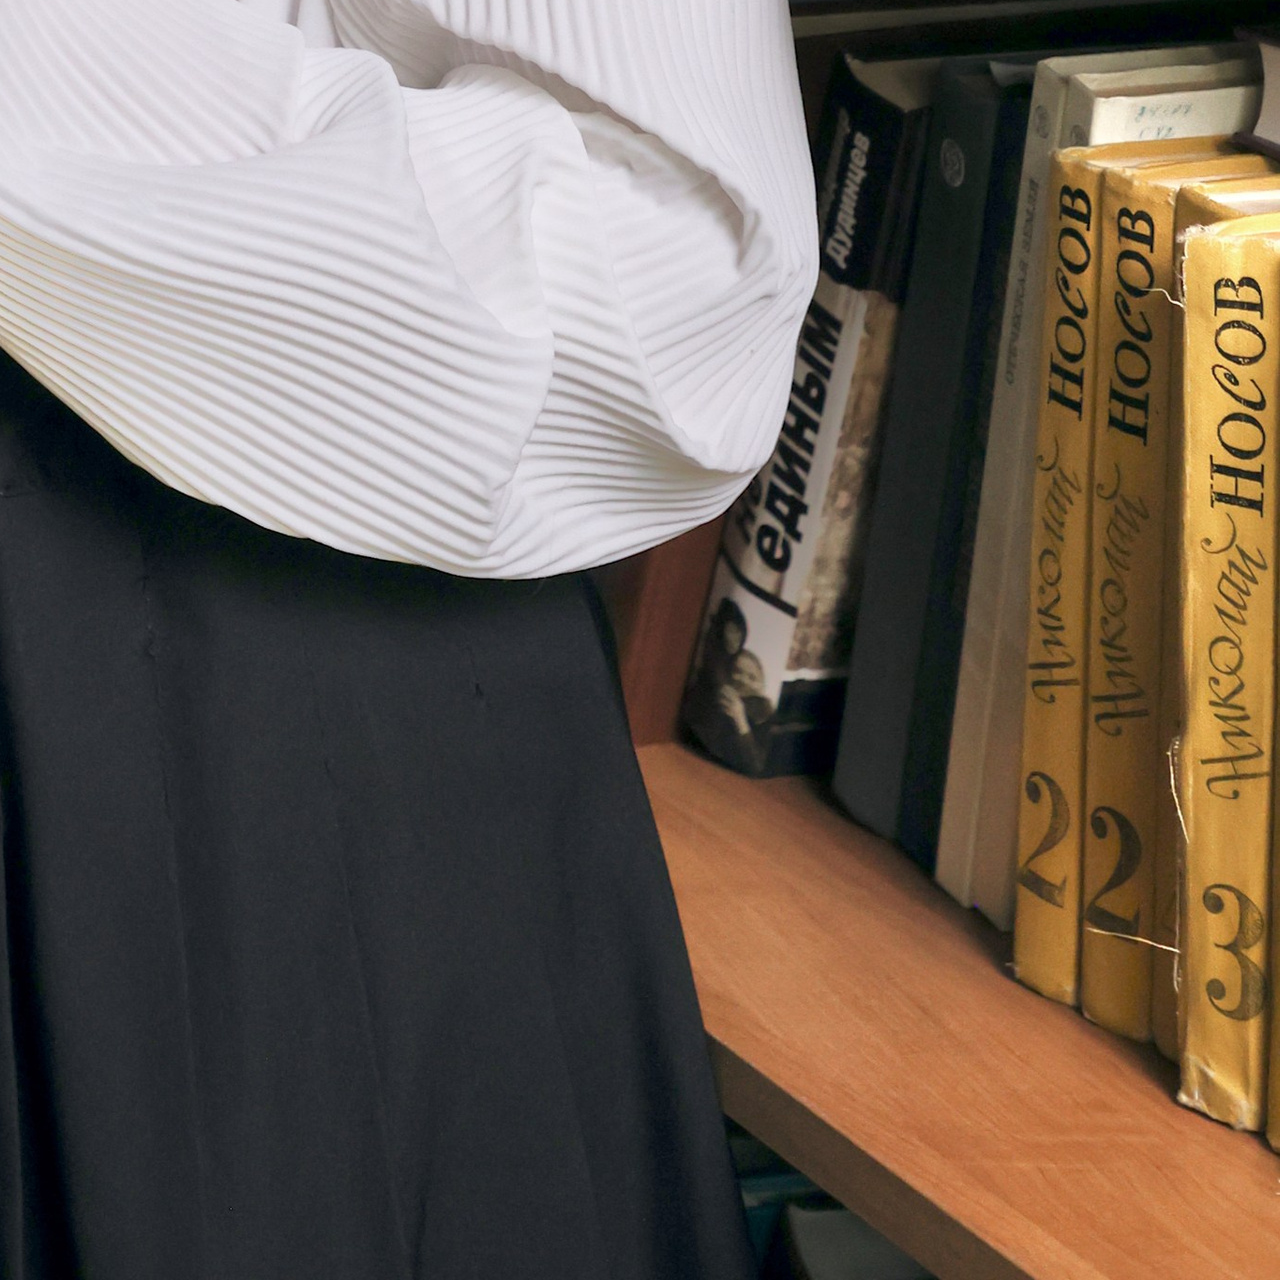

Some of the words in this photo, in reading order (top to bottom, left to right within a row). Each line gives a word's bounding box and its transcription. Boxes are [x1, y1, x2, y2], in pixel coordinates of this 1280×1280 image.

[824, 131, 871, 273] Дудинцев
[1048, 184, 1093, 422] НОСОВ
[755, 300, 845, 574] единым
[1107, 207, 1156, 447] НОСОВ
[1209, 275, 1268, 519] НОСОВ
[1028, 437, 1084, 705] Николай
[1091, 462, 1150, 738] Николай
[1199, 511, 1272, 801] Николай
[1016, 770, 1071, 909] 2
[1085, 805, 1144, 945] 2
[1201, 882, 1270, 1023] 3
